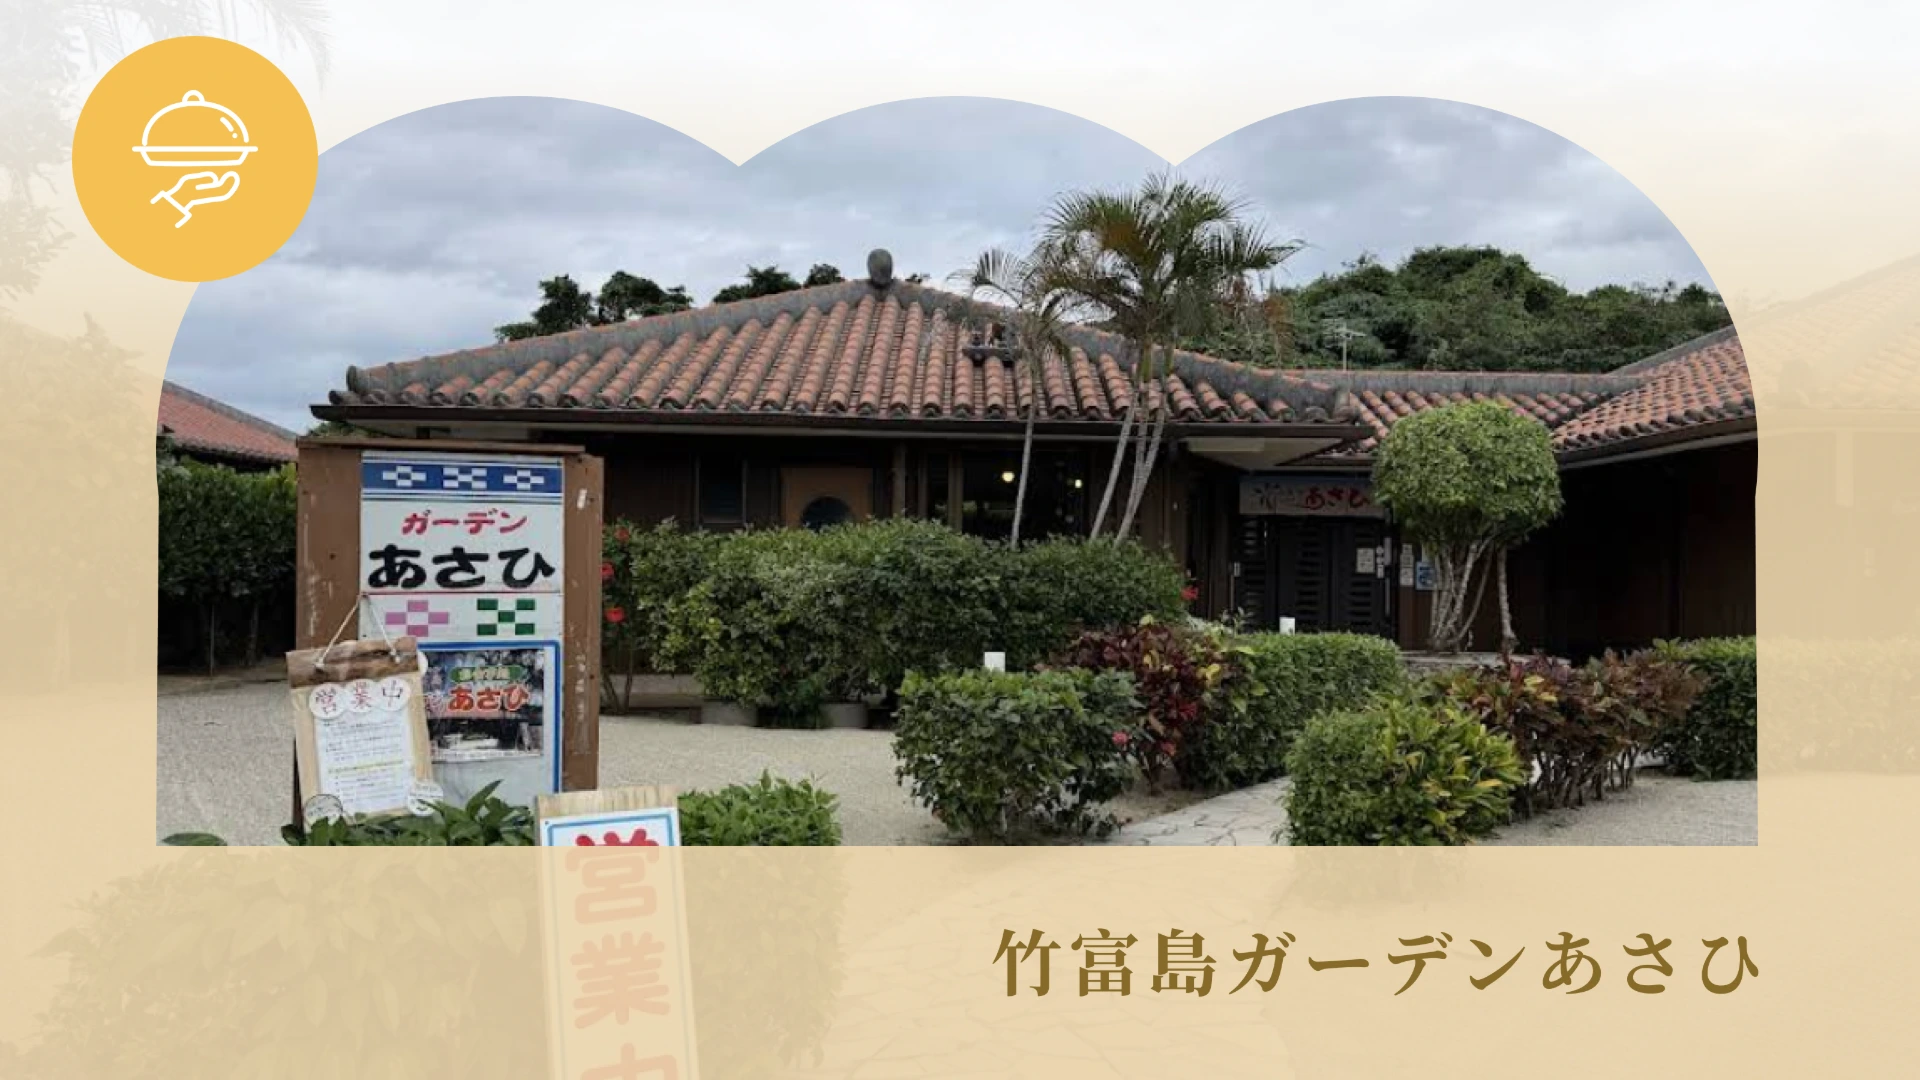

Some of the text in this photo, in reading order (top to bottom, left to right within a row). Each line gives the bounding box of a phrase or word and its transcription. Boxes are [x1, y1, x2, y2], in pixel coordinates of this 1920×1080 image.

[401, 508, 529, 535] ガーデン
[368, 544, 555, 589] あさひ
[315, 680, 403, 716] 営業中
[447, 683, 530, 711] あさひ
